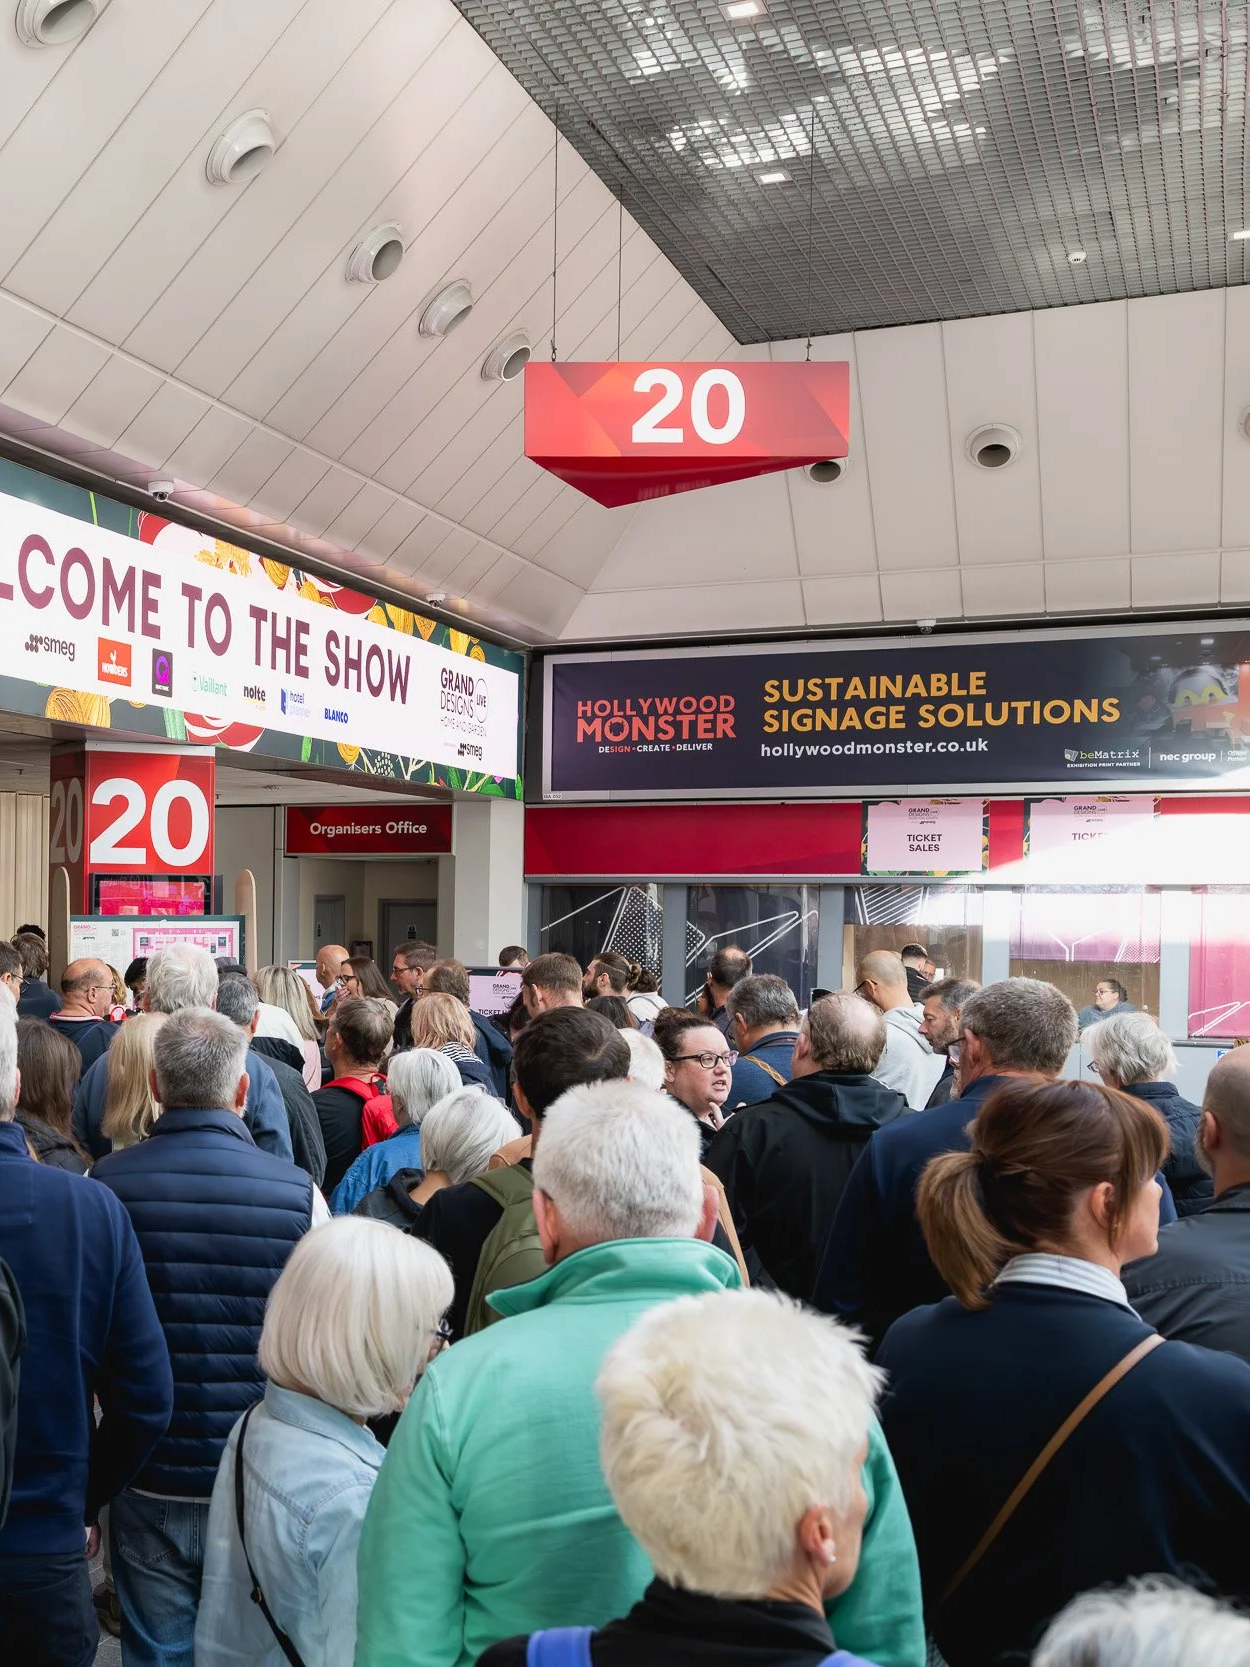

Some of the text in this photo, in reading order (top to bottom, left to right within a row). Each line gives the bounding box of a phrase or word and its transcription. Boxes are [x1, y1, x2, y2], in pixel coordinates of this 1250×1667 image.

[632, 368, 746, 445] 20
[43, 636, 75, 661] smeg
[181, 582, 232, 656] TO
[249, 604, 310, 679] THE
[324, 629, 411, 705] SHOW
[199, 675, 228, 696] Vaillant
[440, 667, 474, 697] GRAND
[763, 671, 987, 703] SUSTAINABLE
[243, 685, 266, 702] nolte
[290, 690, 305, 704] hotel
[440, 690, 474, 718] DESIGNS
[476, 694, 487, 708] LIVE
[324, 708, 349, 724] BLANCO
[577, 695, 736, 717] HOLLYWOOD
[762, 697, 1121, 733] SIGNAGE SOLUTIONS
[576, 713, 737, 743] MONSTER
[466, 743, 483, 761] smeg
[598, 743, 713, 753] DESIGN CREATE DELIVER
[760, 738, 989, 760] hollywoodmonster.co.uk
[1080, 749, 1140, 760] beMatrix
[1159, 751, 1216, 763] nec group
[50, 777, 84, 864] 20
[90, 777, 210, 867] 20
[309, 821, 427, 838] Organisers Office
[906, 834, 942, 842] TICKET
[909, 844, 940, 852] SALES
